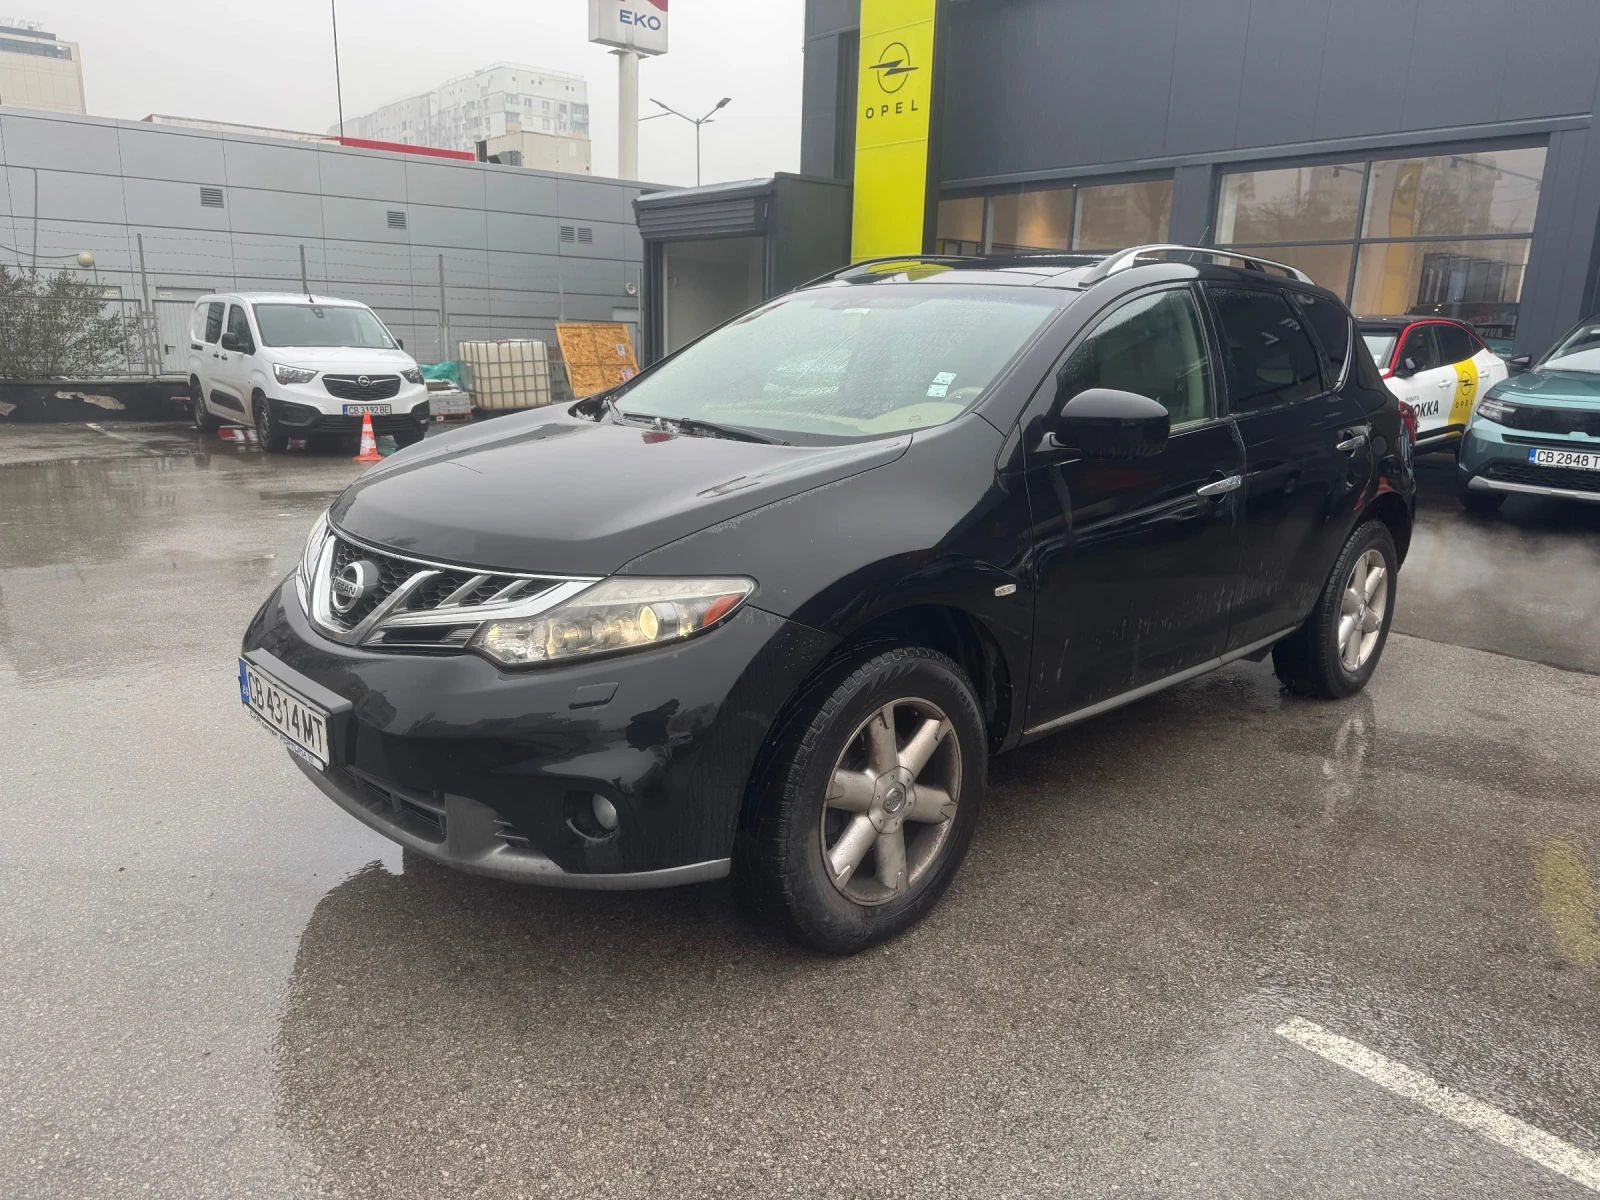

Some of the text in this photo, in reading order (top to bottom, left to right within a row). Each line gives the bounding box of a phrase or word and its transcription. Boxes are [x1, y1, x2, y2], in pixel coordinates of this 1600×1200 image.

[620, 9, 662, 31] EKO
[866, 99, 918, 119] OPEL
[349, 406, 359, 414] CB
[380, 405, 390, 415] BE
[1455, 399, 1474, 409] OPEL
[1537, 450, 1555, 464] CB
[1556, 453, 1590, 468] 2848
[248, 671, 264, 711] CB
